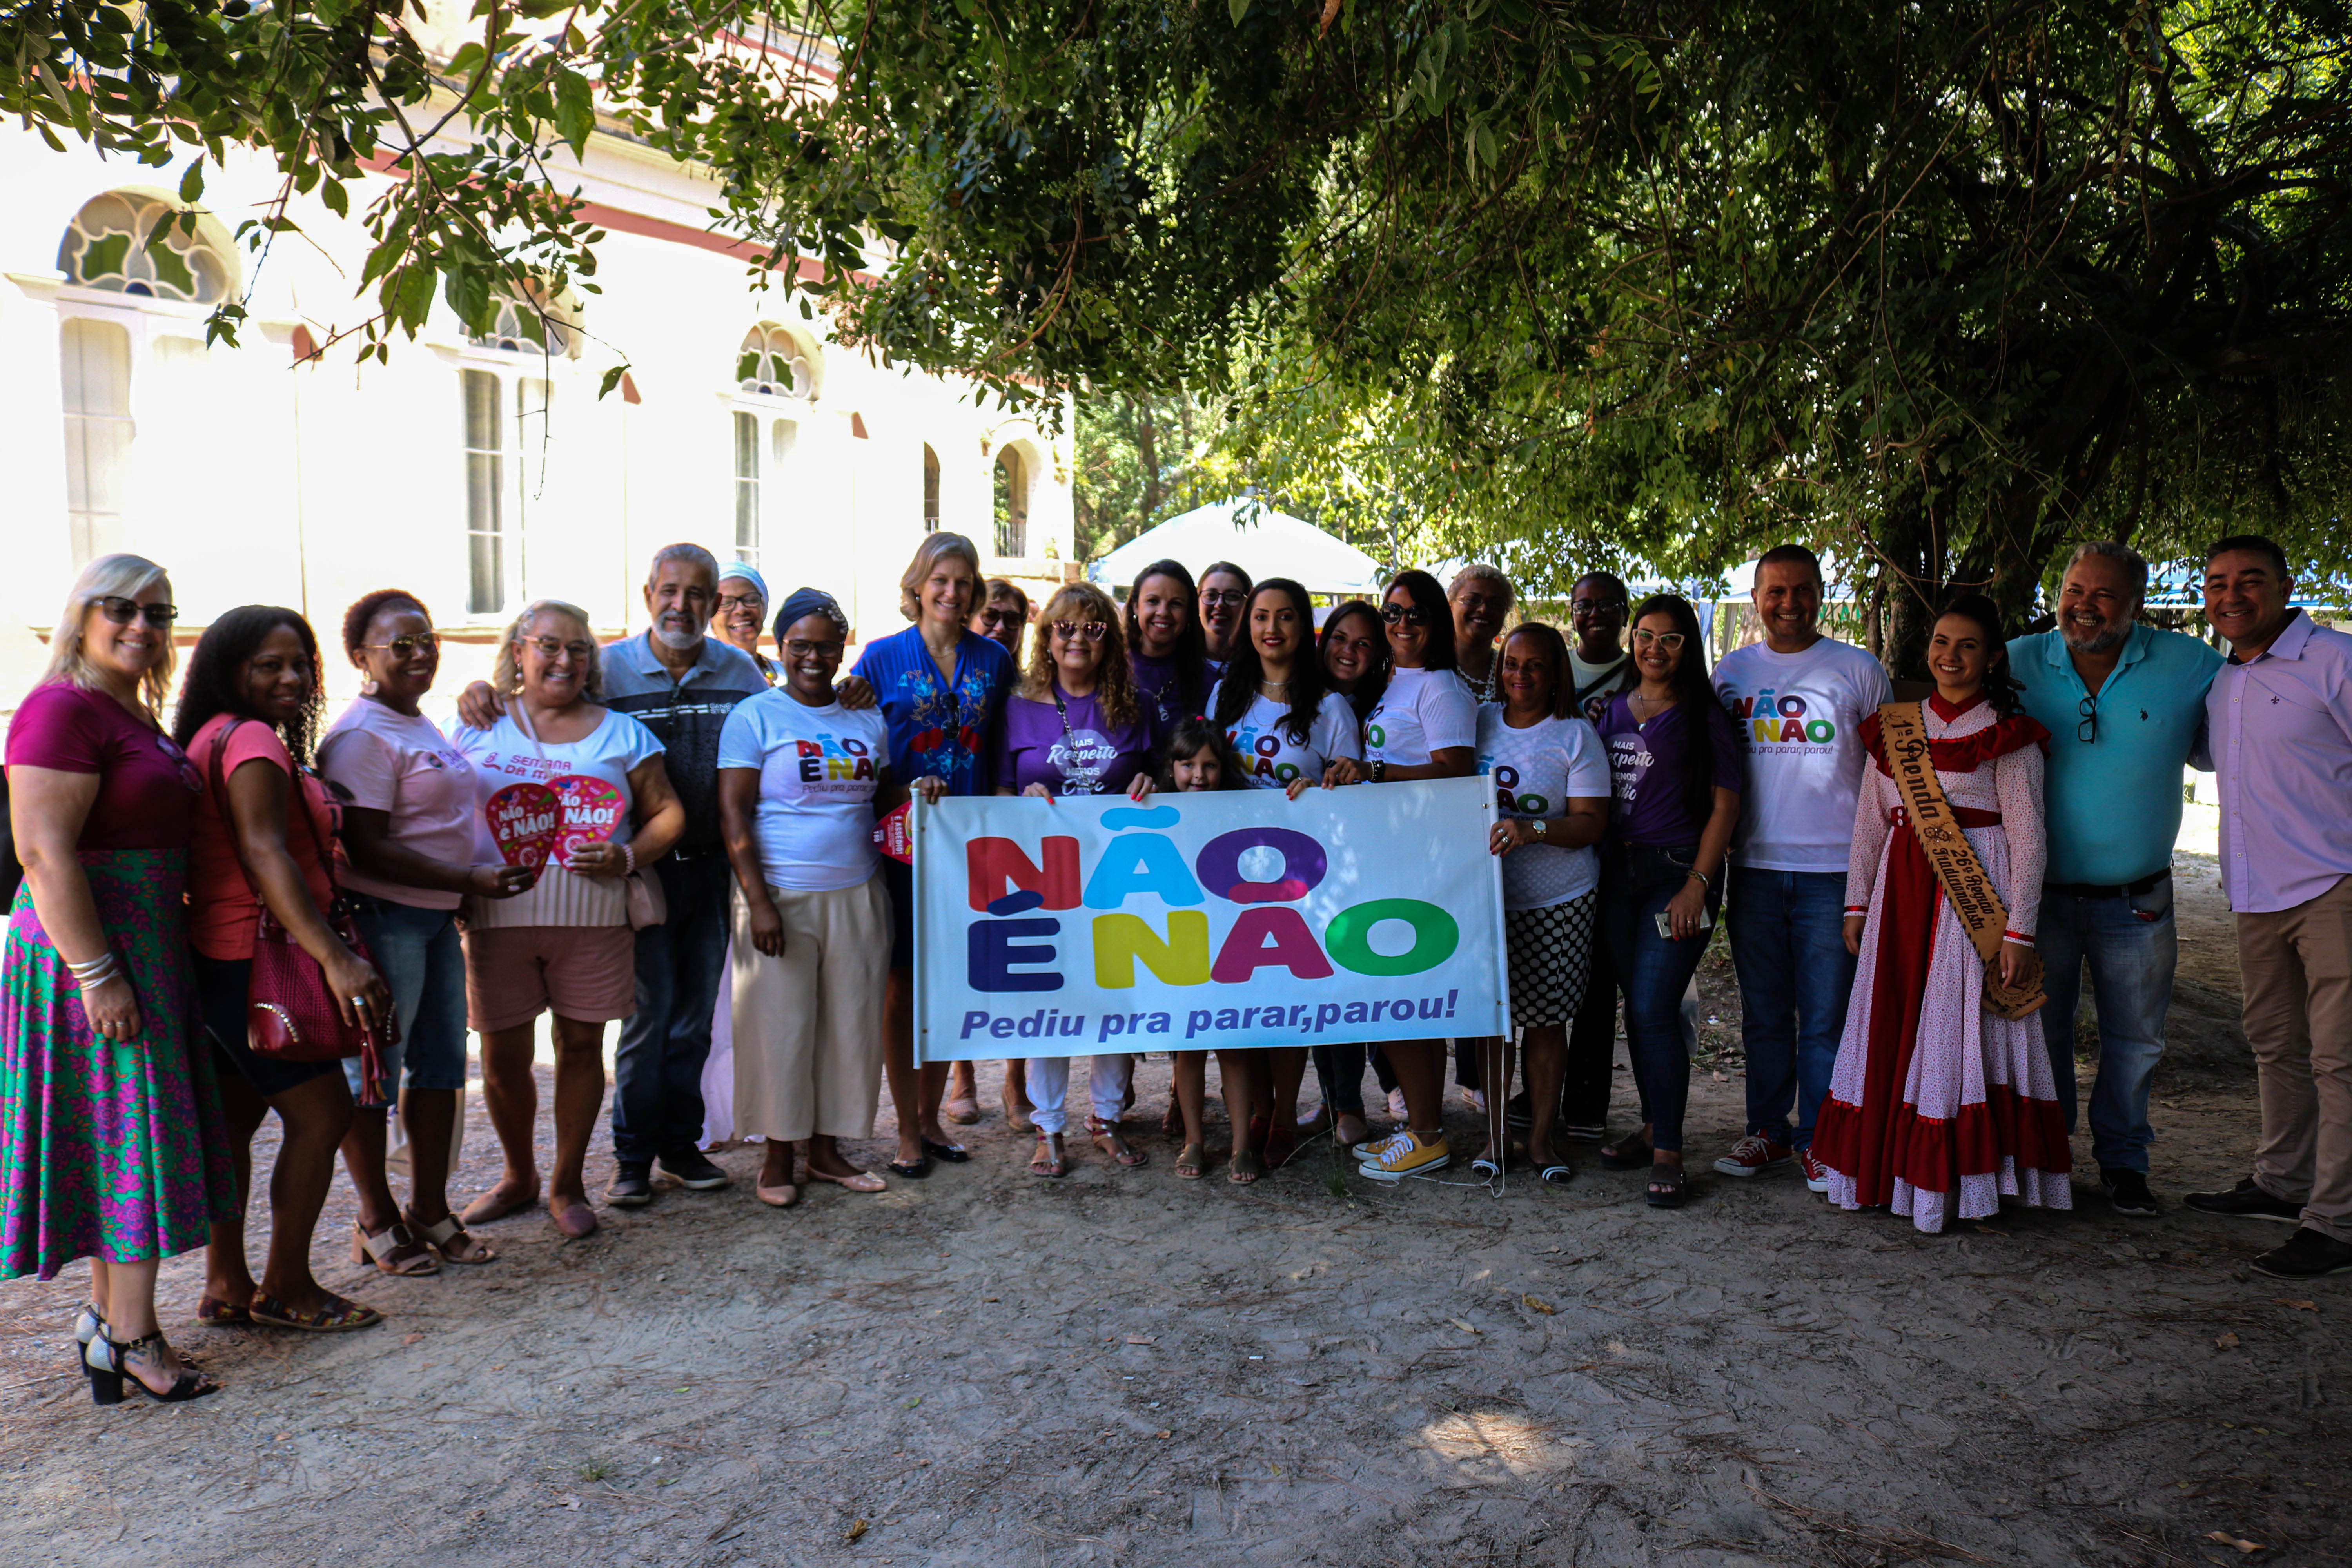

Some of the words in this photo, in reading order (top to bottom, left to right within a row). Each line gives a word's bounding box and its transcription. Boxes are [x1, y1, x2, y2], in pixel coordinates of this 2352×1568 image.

[1732, 688, 1807, 719] NÃO
[1753, 711, 1835, 744] NÃO
[796, 733, 868, 758] NÃO
[1074, 738, 1094, 747] AIS
[1613, 740, 1635, 750] MAIS
[1759, 746, 1773, 755] pra
[1775, 746, 1801, 755] parar,
[1804, 746, 1833, 756] parou!
[504, 764, 526, 776] DA
[799, 751, 822, 782] É
[1608, 750, 1655, 768] espeito
[802, 784, 828, 793] Pediu
[1895, 739, 1943, 821] Prenda
[499, 806, 524, 822] NÃO
[561, 793, 581, 807] ÃO
[563, 804, 615, 824] NÃO!
[499, 823, 510, 841] é
[512, 812, 555, 838] NÃO!
[894, 822, 904, 855] ASSÉDIO!
[966, 806, 1328, 913] NÃO
[1932, 848, 1985, 932] Tradicionalista
[1964, 875, 1996, 915] Região
[967, 890, 1064, 993] É
[1092, 879, 1460, 990] NÃO
[960, 1009, 1086, 1040] Pediu
[1098, 1012, 1171, 1043] pra
